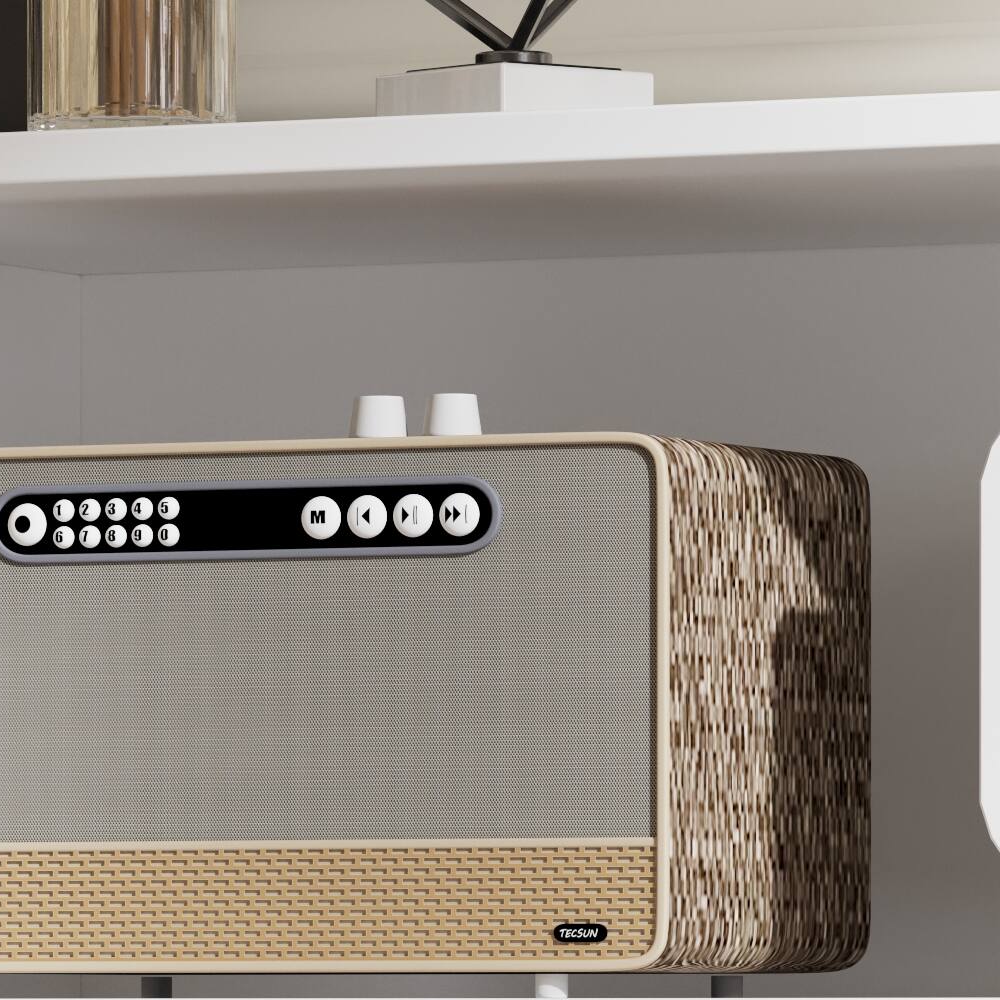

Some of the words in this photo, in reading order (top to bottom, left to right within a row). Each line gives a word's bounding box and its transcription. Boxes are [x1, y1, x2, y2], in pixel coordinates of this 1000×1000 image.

[56, 504, 62, 516] 1
[81, 503, 89, 516] 2
[107, 502, 116, 515] 3
[133, 502, 142, 514] 4
[160, 501, 169, 514] 5
[310, 510, 326, 524] M
[55, 530, 64, 543] 6
[82, 530, 89, 542] 7
[107, 529, 116, 542] 8
[133, 529, 142, 542] 9
[160, 528, 169, 541] 0
[559, 927, 599, 938] TECSUN
